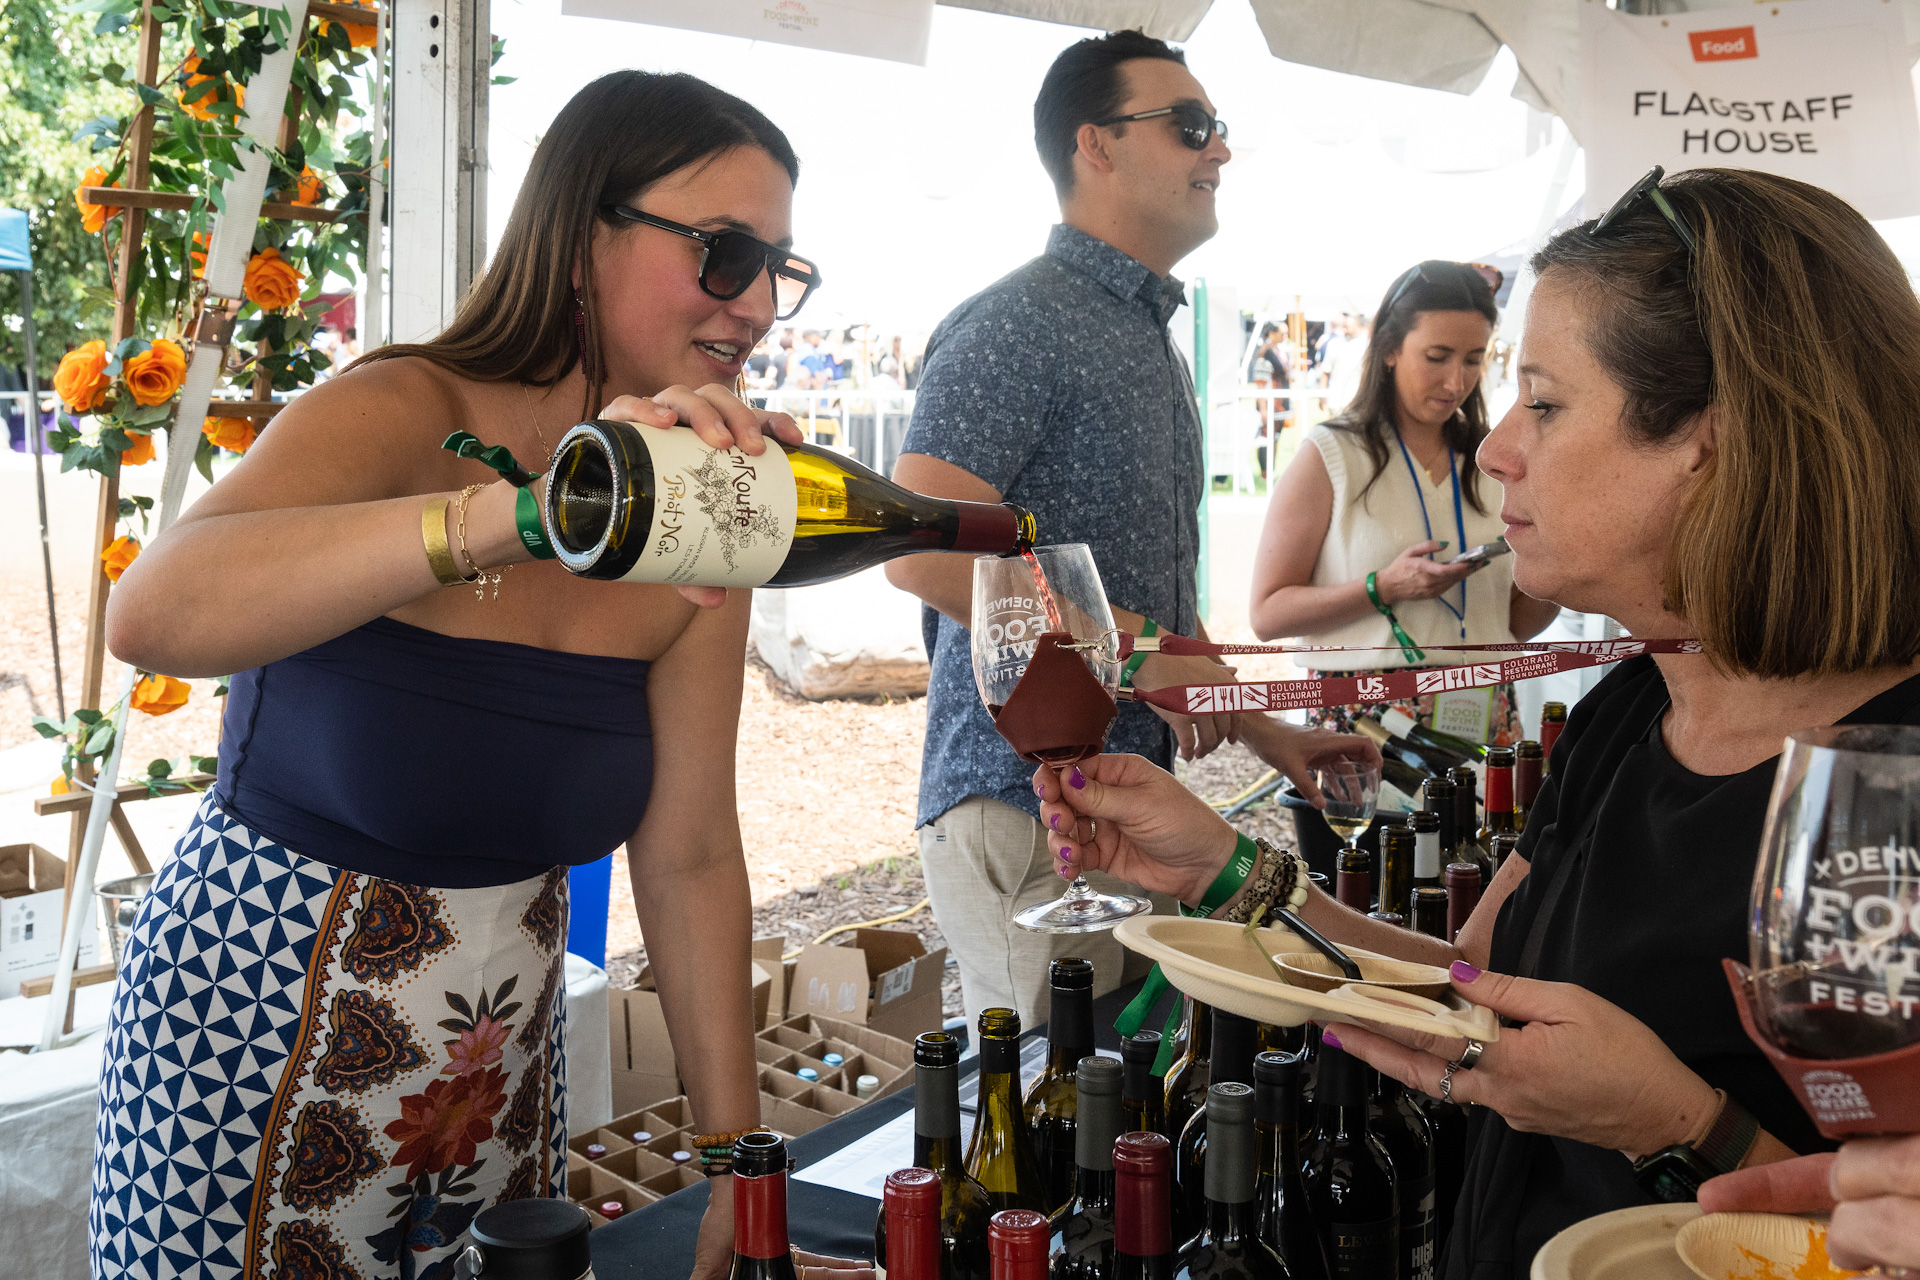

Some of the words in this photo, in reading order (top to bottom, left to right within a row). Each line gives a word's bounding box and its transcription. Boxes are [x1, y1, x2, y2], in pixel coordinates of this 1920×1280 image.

[1701, 37, 1746, 56] Food
[1633, 90, 1854, 123] FLAGSTAFF
[1682, 128, 1818, 154] HOUSE
[662, 474, 687, 522] Pinot
[523, 530, 543, 548] VIP
[654, 519, 683, 558] Noir
[1503, 653, 1558, 670] COLORADO
[1504, 660, 1558, 676] RESTAURANT
[1504, 666, 1559, 681] FOUNDATION
[1270, 681, 1322, 693] COLORADO
[1271, 689, 1323, 701] RESTAURANT
[1271, 699, 1323, 709] FOUNDATION
[1357, 692, 1386, 701] FOODS
[1235, 855, 1254, 878] VIP
[1805, 1082, 1863, 1099] FOOD
